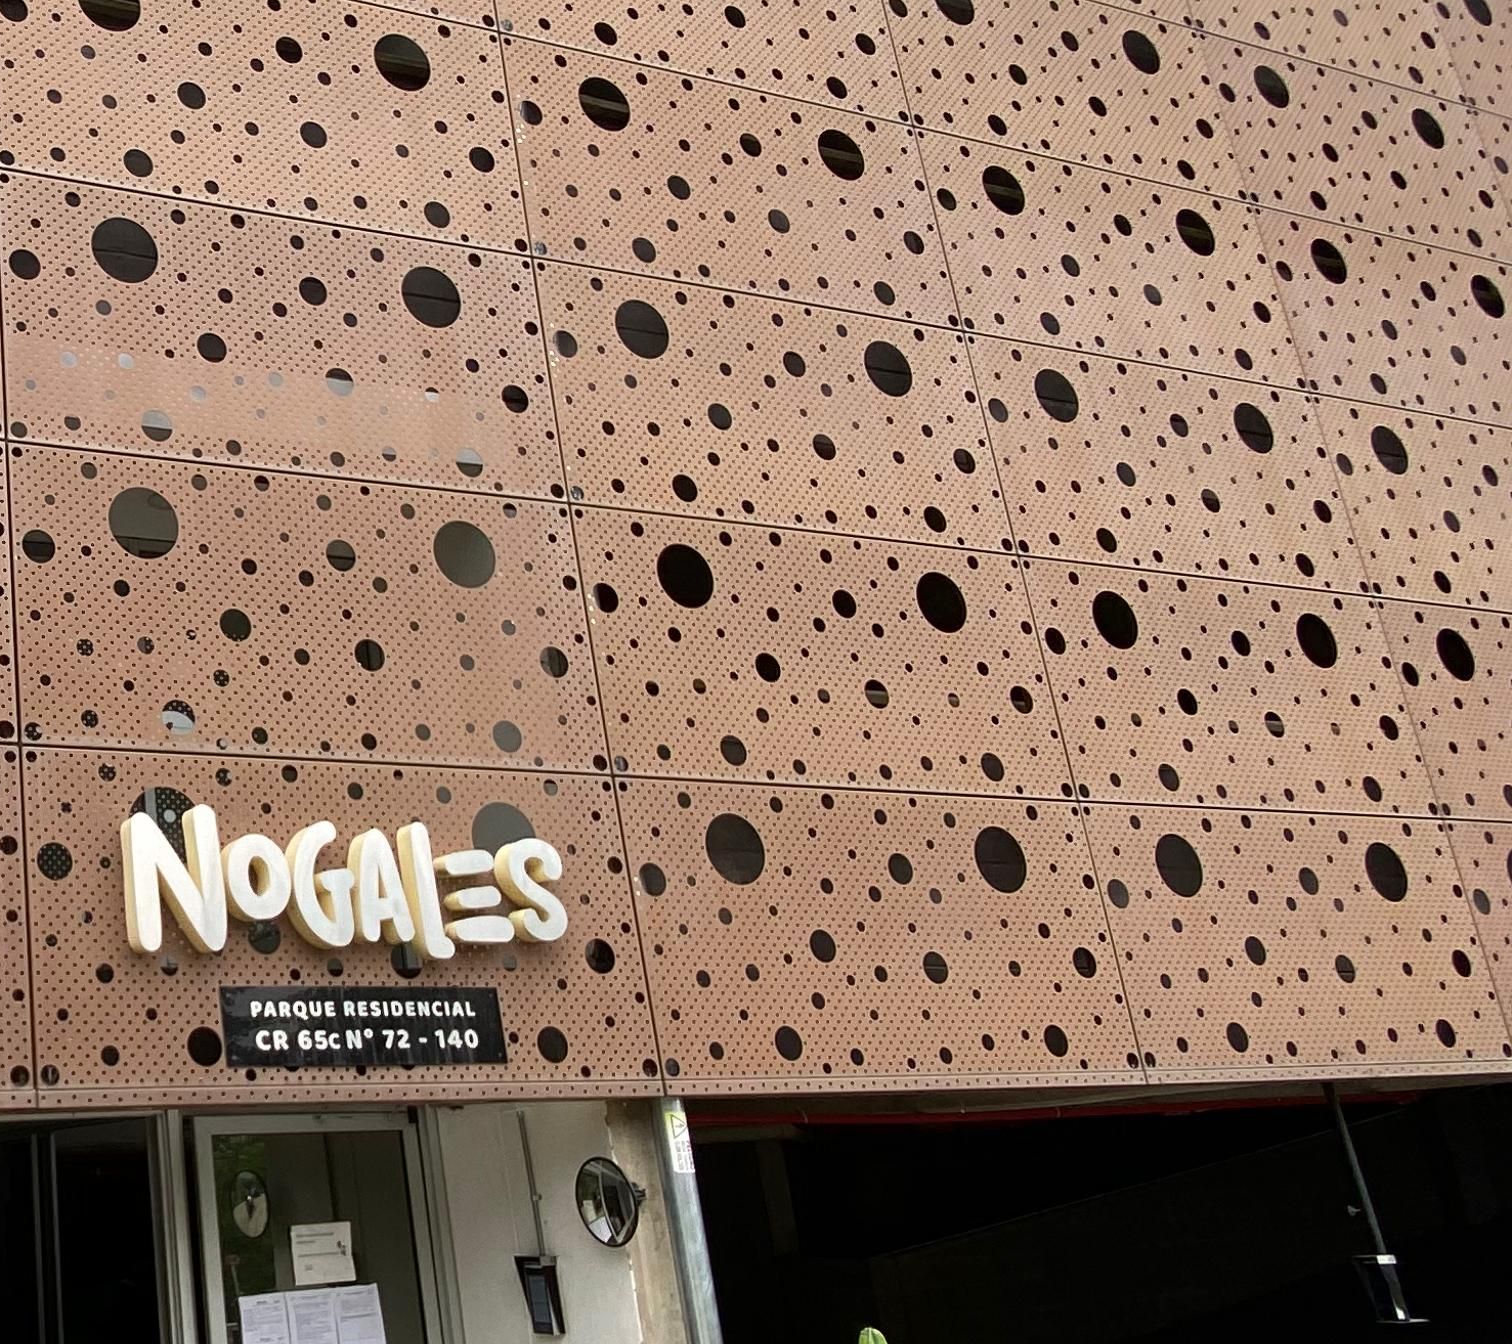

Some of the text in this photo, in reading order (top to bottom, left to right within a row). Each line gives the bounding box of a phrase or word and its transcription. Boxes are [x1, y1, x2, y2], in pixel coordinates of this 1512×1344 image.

[250, 1000, 476, 1020] PARQUE RESIDENCIAL
[255, 1030, 289, 1051] CR
[382, 1029, 410, 1049] 72
[434, 1029, 479, 1049] 140
